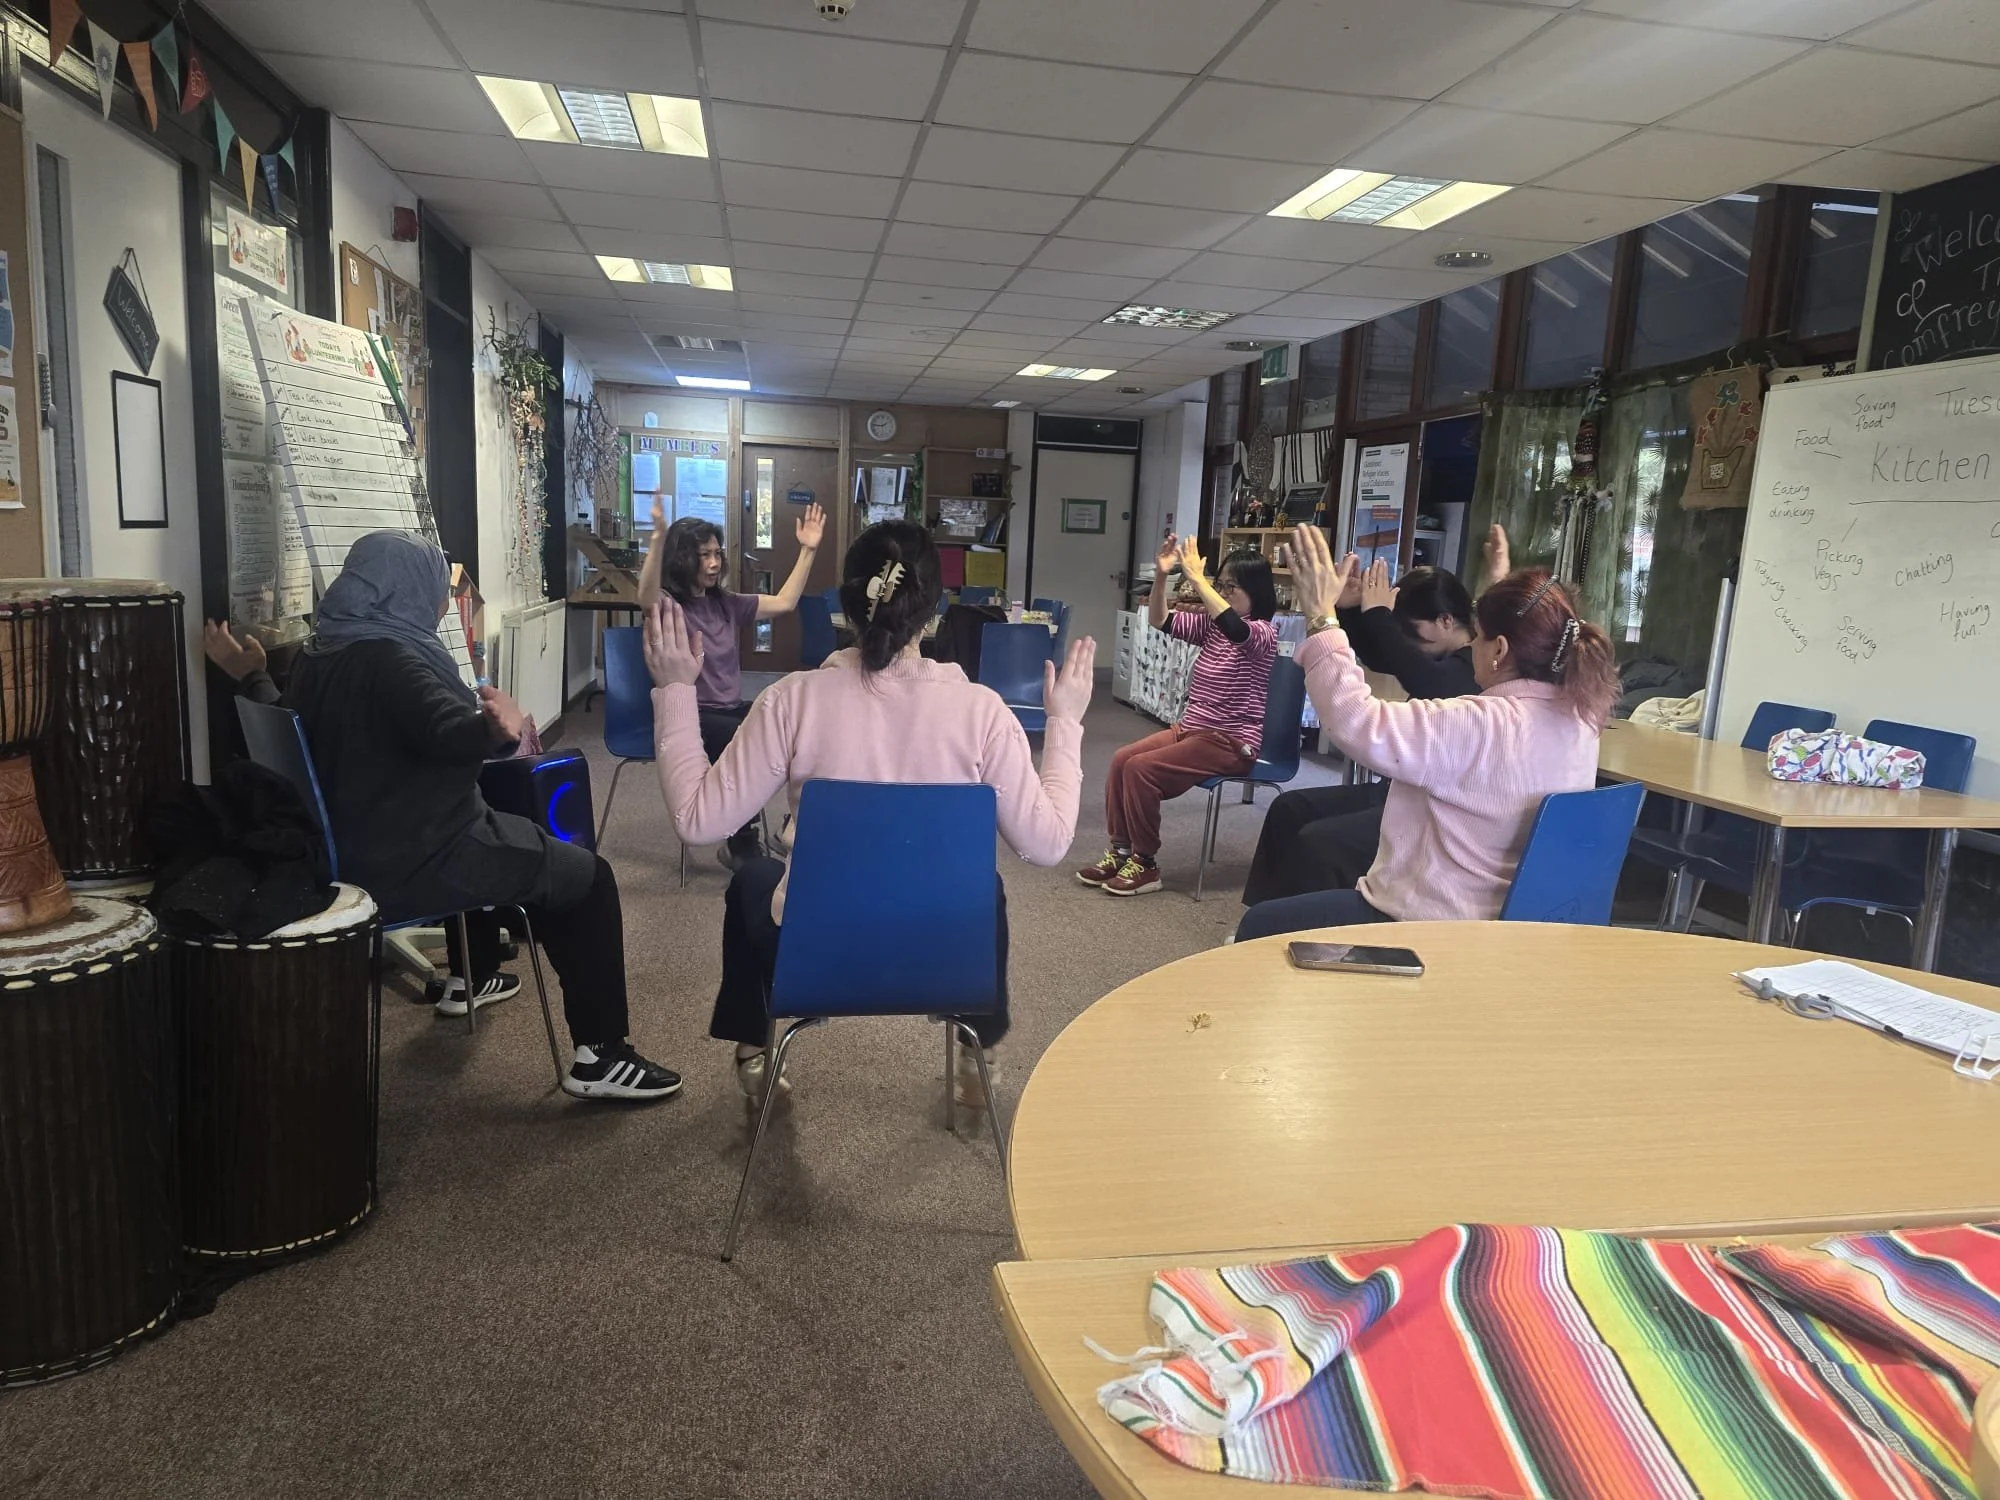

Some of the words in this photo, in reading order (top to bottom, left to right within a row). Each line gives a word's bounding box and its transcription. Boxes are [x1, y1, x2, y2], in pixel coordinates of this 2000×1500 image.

[1853, 392, 1897, 420] Saving
[1855, 415, 1885, 431] food
[640, 435, 721, 456] MEMBERS
[1794, 429, 1833, 447] Food
[1871, 442, 1990, 483] Kitchen
[1771, 481, 1810, 501] Eating
[1768, 507, 1816, 525] drinking
[1816, 538, 1864, 576] Picking
[1895, 552, 1955, 588] Chatting
[1939, 596, 1990, 628] Having
[1836, 615, 1878, 660] Serving
[1836, 636, 1858, 664] food
